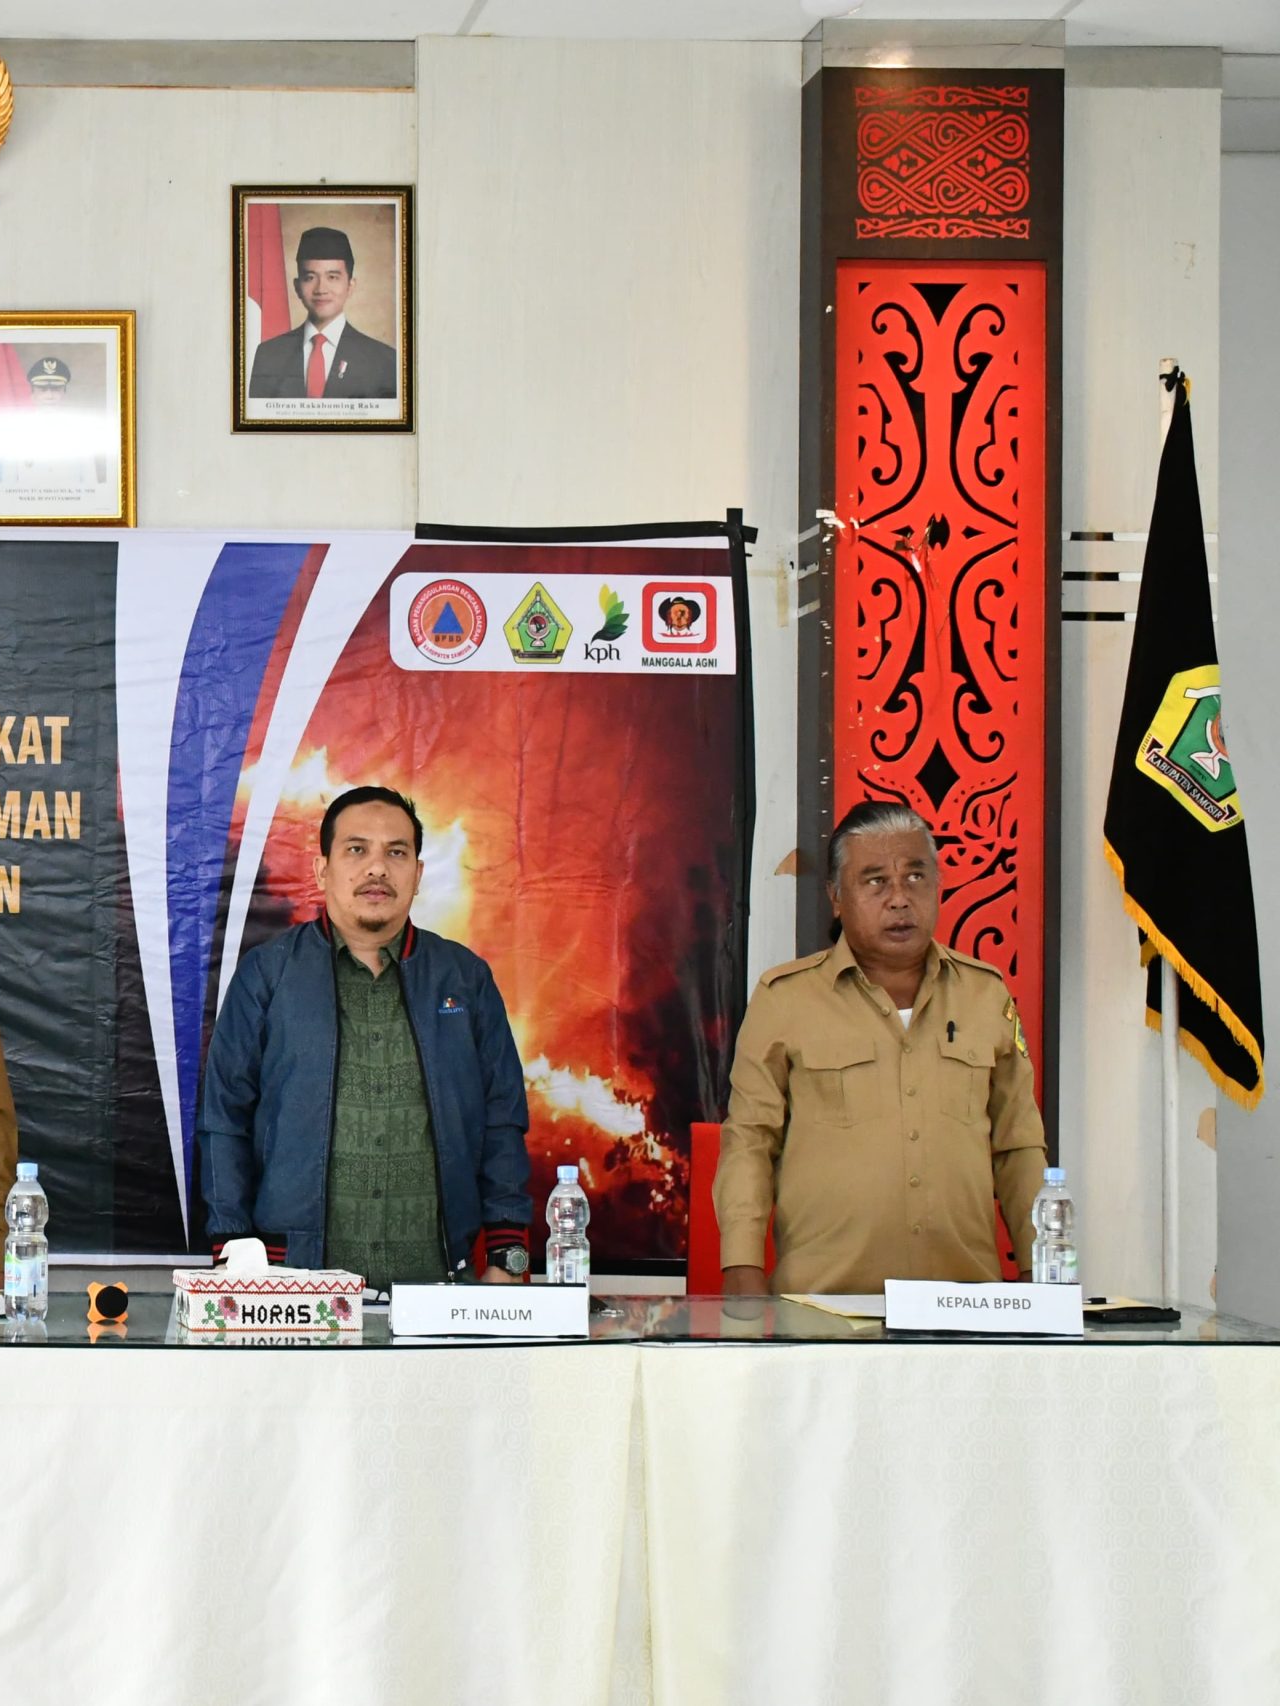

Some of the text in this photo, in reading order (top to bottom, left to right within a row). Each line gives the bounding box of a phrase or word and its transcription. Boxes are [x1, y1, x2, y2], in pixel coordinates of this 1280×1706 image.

[584, 643, 621, 664] kph
[641, 657, 718, 668] MANGGALA AGNI
[1149, 754, 1193, 792] KABUPATEN
[1190, 788, 1223, 819] SAMOSIR
[936, 1296, 1032, 1310] KEPALA BPBD
[241, 1304, 311, 1325] HORAS
[450, 1308, 533, 1321] PT. INALUM
